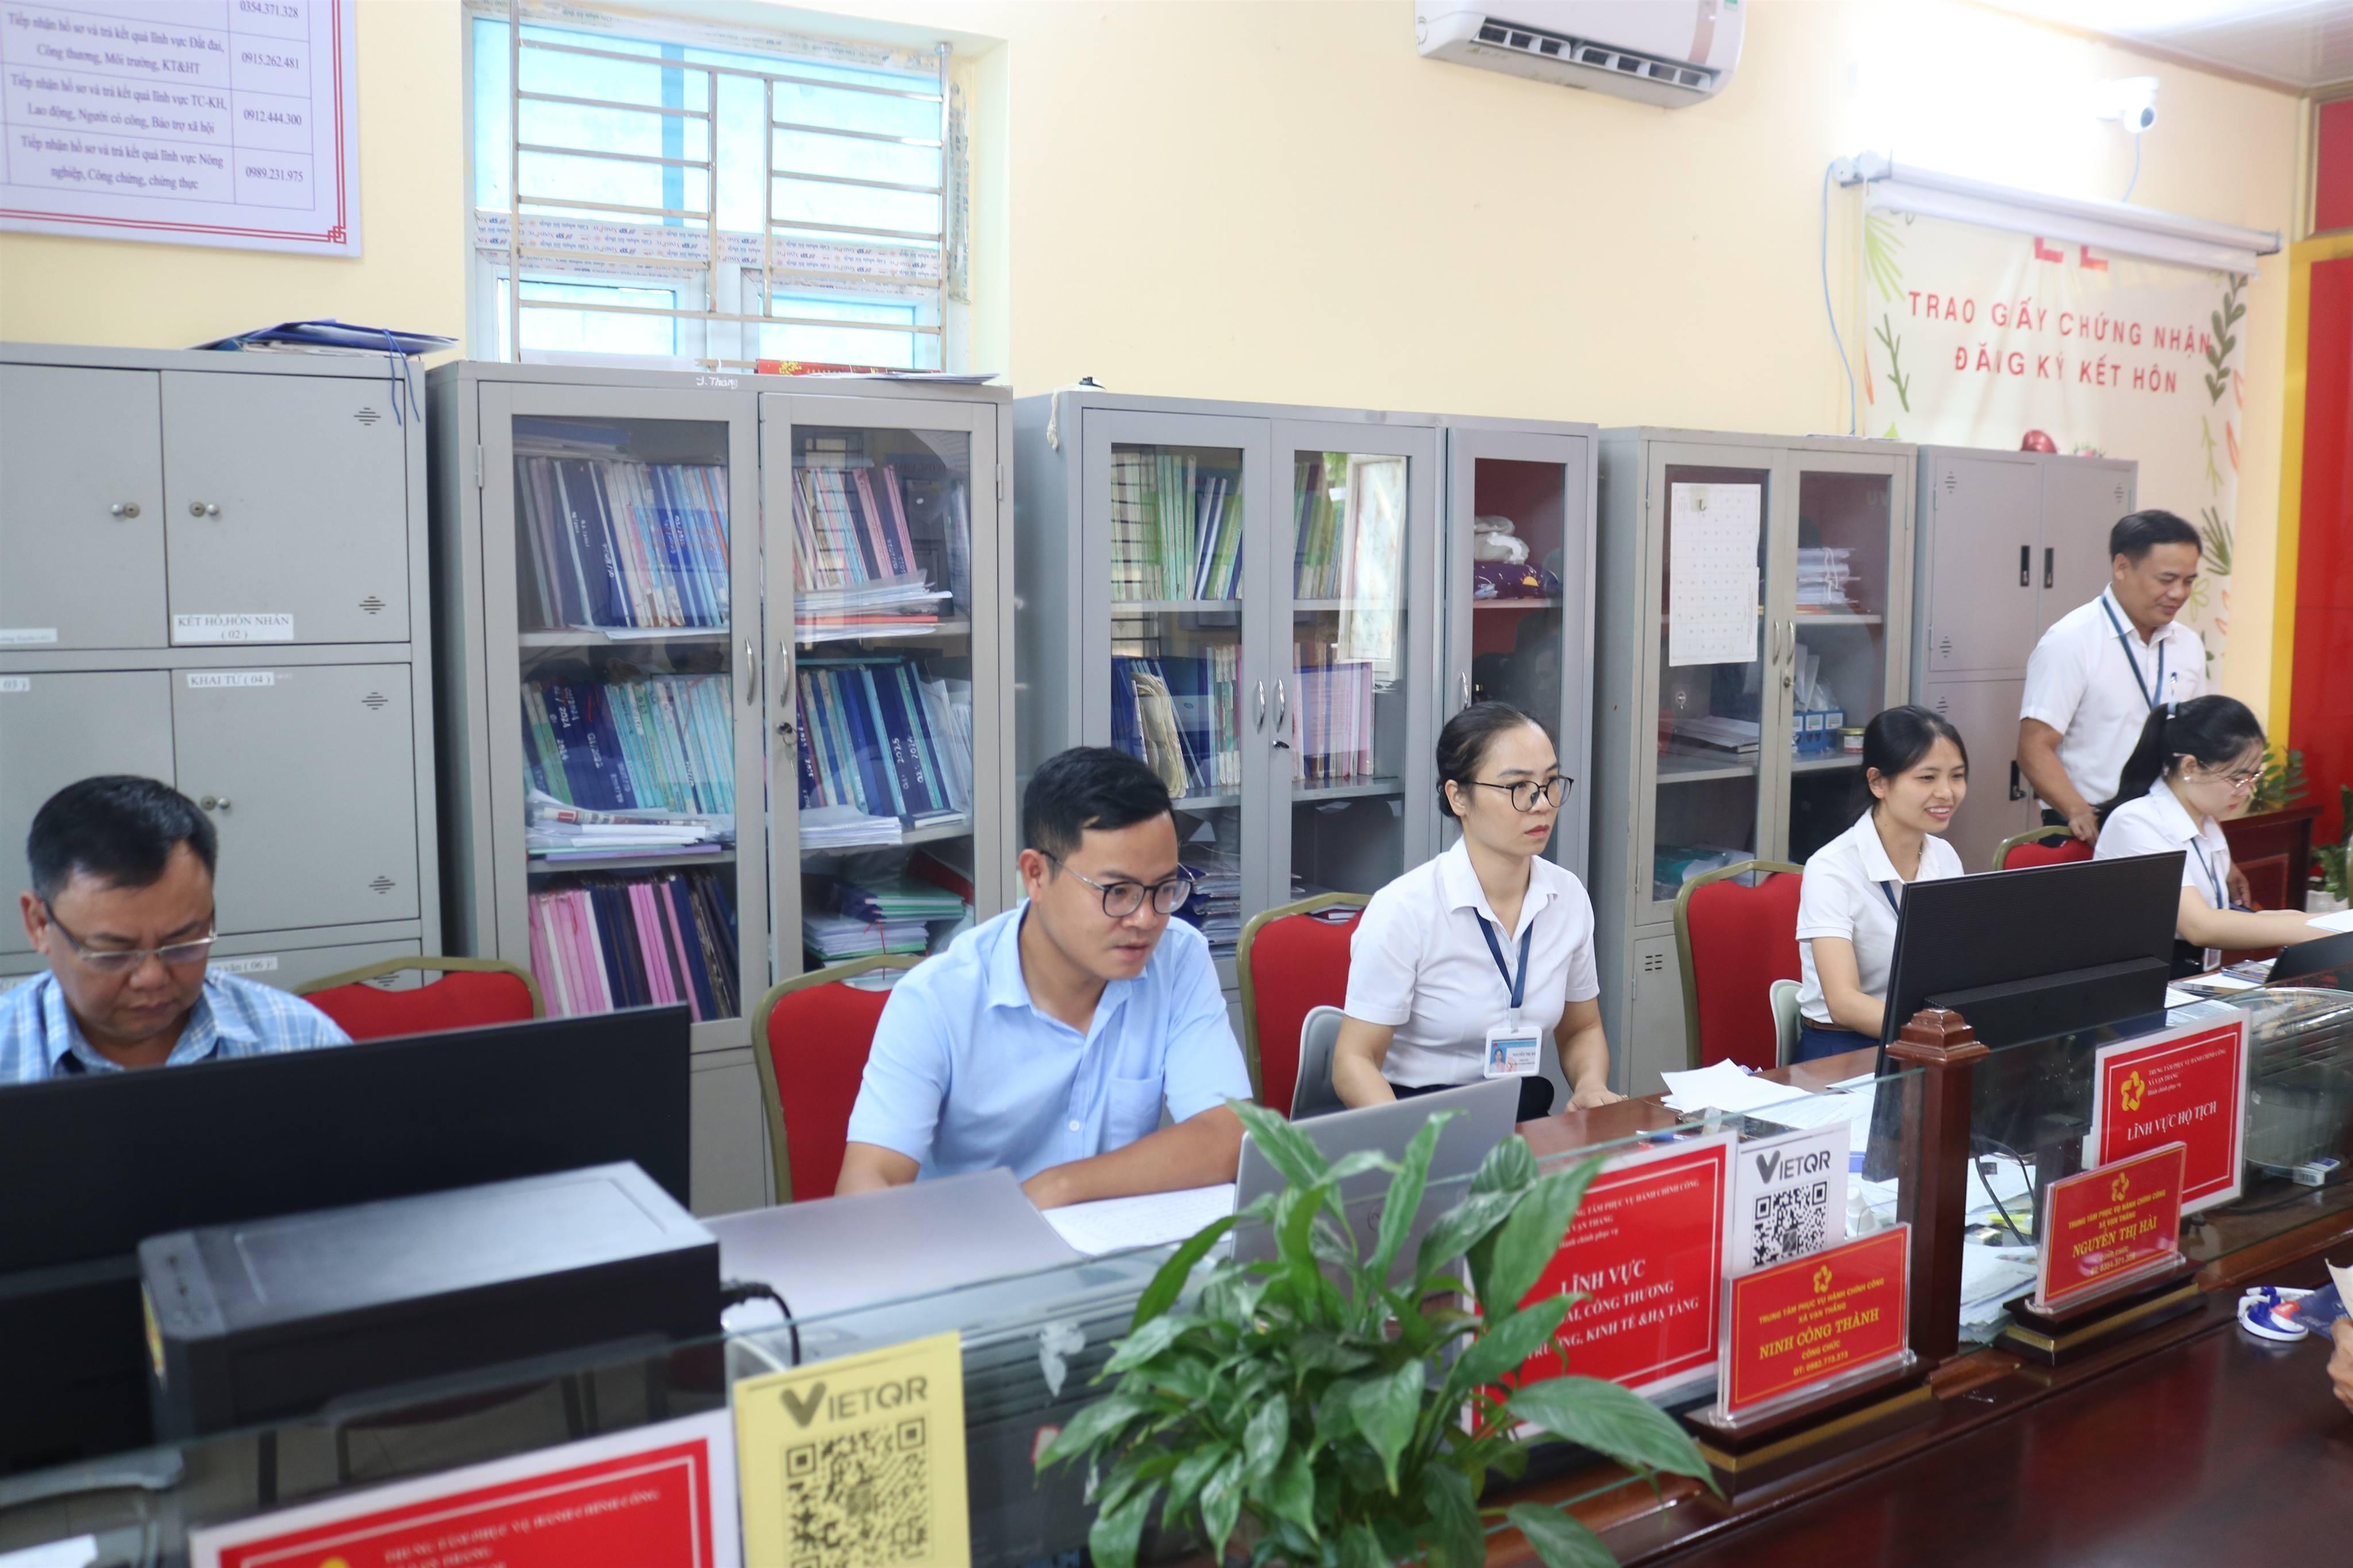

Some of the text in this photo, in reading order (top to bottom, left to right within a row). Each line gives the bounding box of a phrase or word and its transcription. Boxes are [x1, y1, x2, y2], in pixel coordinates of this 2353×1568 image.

[162, 59, 202, 75] KT&HT
[243, 108, 303, 126] 0912.444.300
[245, 166, 304, 184] 0989.231.975
[1908, 291, 1976, 324] TRAO
[2059, 311, 2142, 346] CHỨNG
[2154, 325, 2211, 358] NHẬN
[2078, 353, 2121, 387] KẾT
[2132, 363, 2177, 393] HÔN
[190, 675, 222, 686] KHAI
[2127, 1100, 2217, 1141] LĨNH VỰC HỘ TỊCH
[1756, 1149, 1831, 1185] VIETQR
[2119, 1223, 2138, 1241] THỊ
[1608, 1258, 1646, 1286] VỰC
[1583, 1296, 1620, 1318] CÔNG
[1623, 1280, 1674, 1306] THƯƠNG
[1586, 1322, 1618, 1342] KINH
[1621, 1314, 1636, 1331] TẾ
[1759, 1311, 1782, 1324] TRUNG
[1759, 1307, 1880, 1361] NINH CÔNG THÀNH
[780, 1374, 928, 1430] VIETQR
